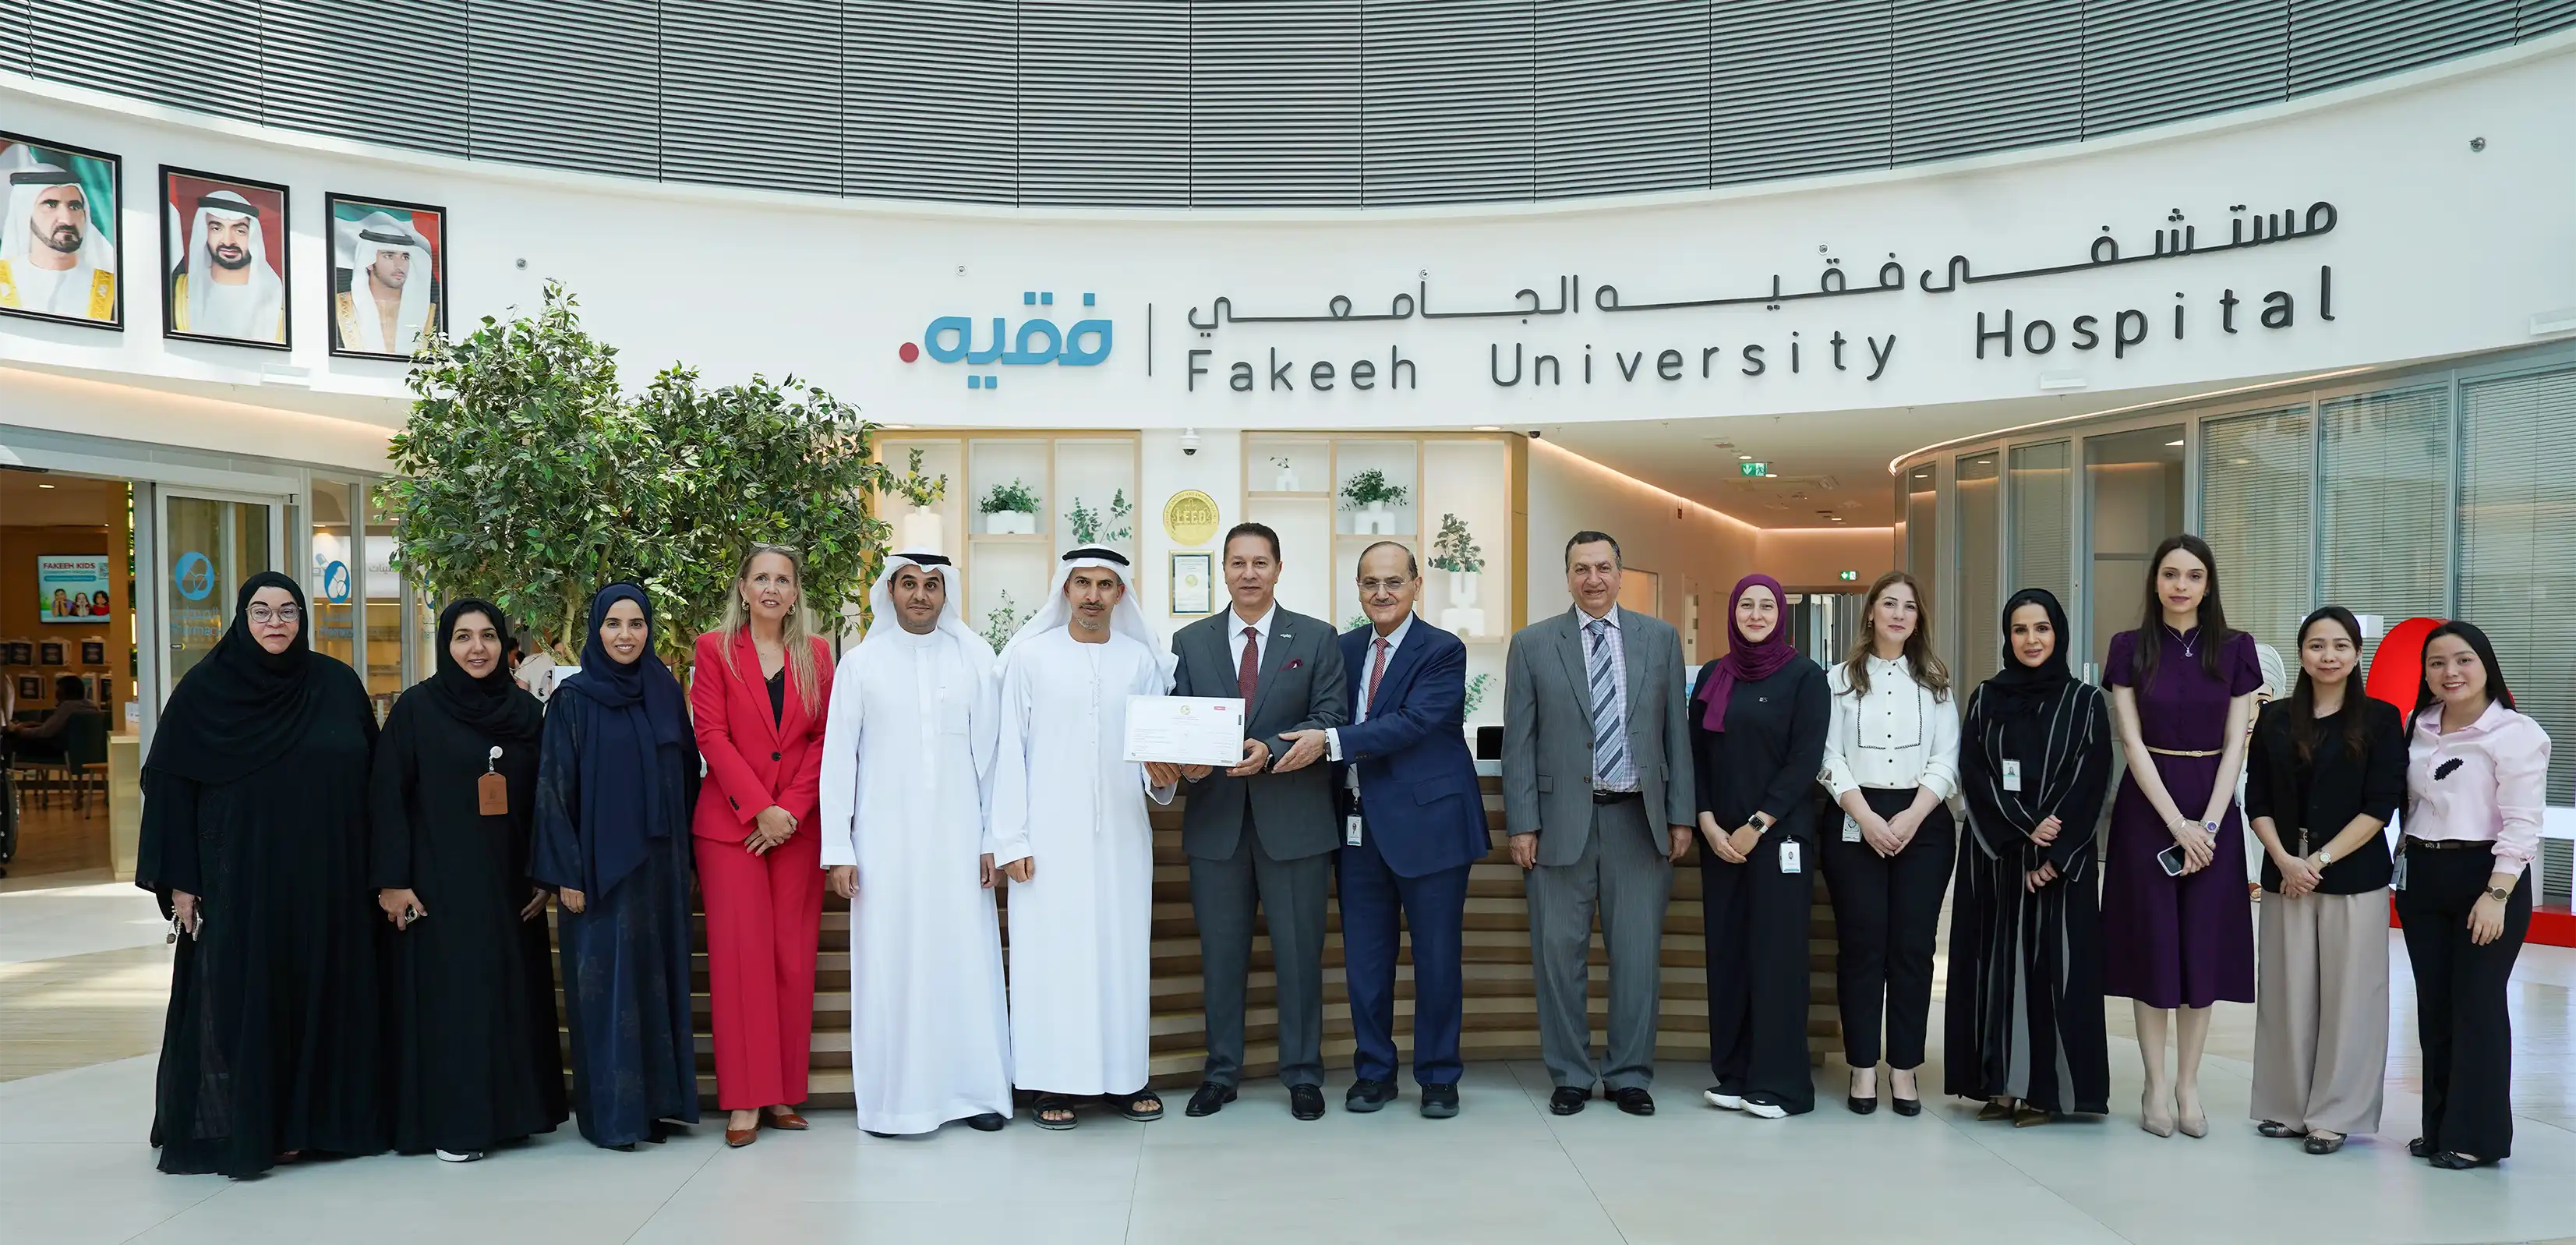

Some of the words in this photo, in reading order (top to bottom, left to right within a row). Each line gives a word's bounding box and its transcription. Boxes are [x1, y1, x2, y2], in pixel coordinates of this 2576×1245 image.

[1188, 274, 1580, 338] الجامعي
[1595, 252, 1905, 313] فقيه
[1188, 345, 1416, 392] Fakeeh
[1491, 331, 1897, 382] University
[1976, 265, 2336, 359] Hospital
